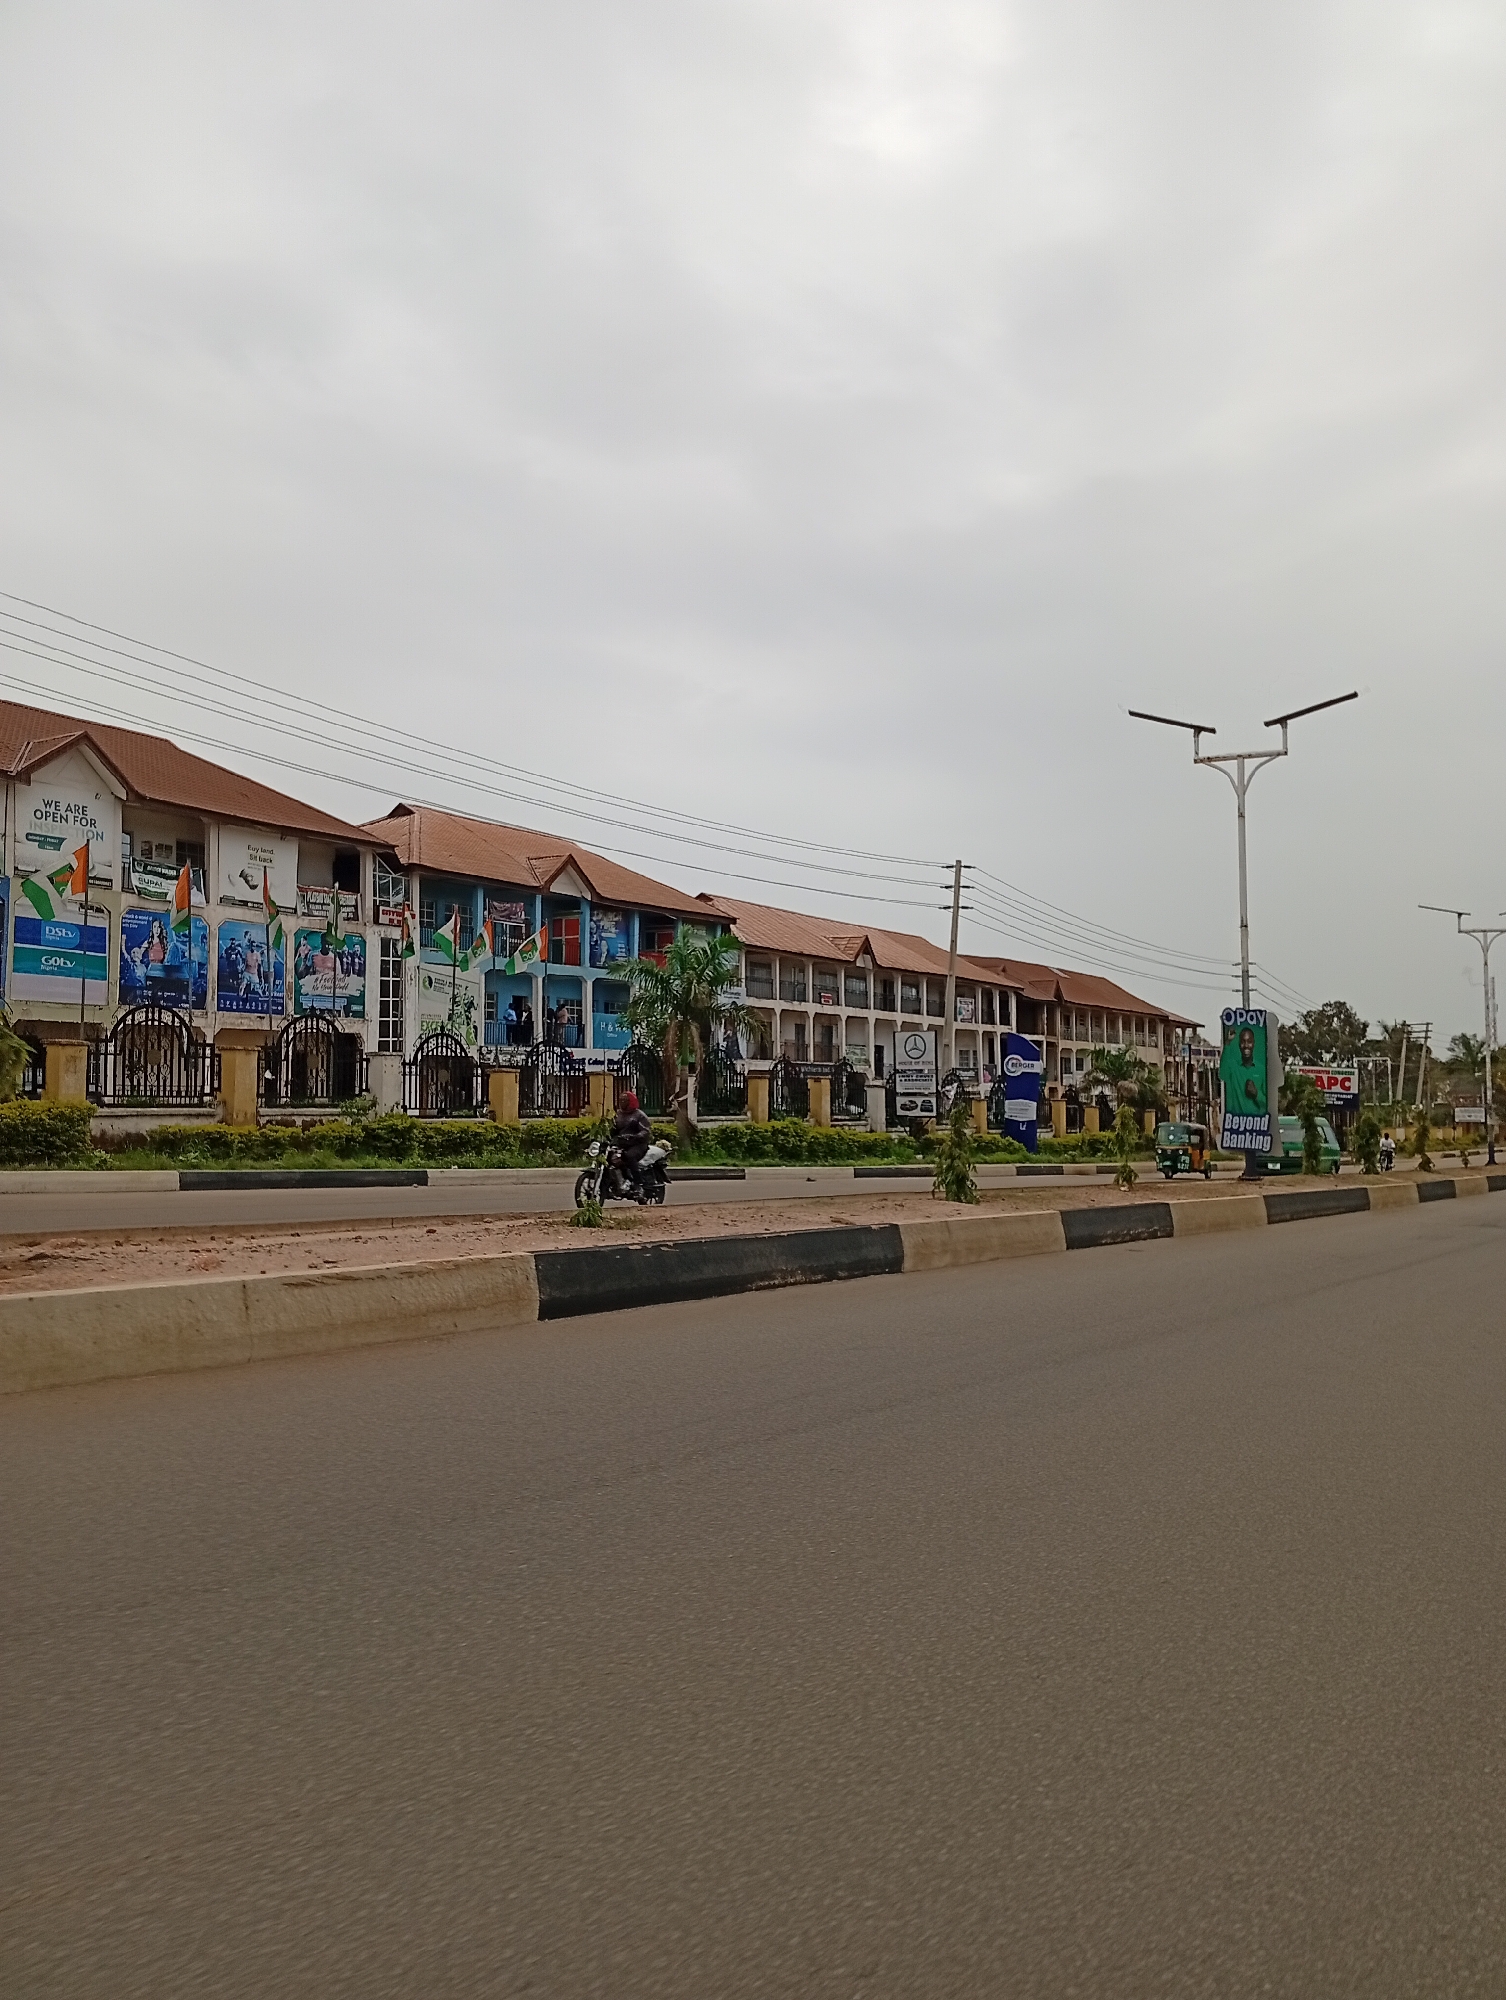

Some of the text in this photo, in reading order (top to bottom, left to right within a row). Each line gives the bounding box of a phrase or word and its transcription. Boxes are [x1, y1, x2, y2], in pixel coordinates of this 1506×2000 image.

[42, 798, 88, 816] WE ARE
[33, 809, 97, 829] OPEN FOR
[29, 820, 104, 842] INSPECTION
[45, 926, 76, 938] DStv
[41, 955, 76, 968] GOtv
[1222, 1008, 1266, 1027] OPay
[1315, 1075, 1352, 1092] APC
[1224, 1113, 1269, 1132] Beyond
[1222, 1131, 1272, 1151] Banking
